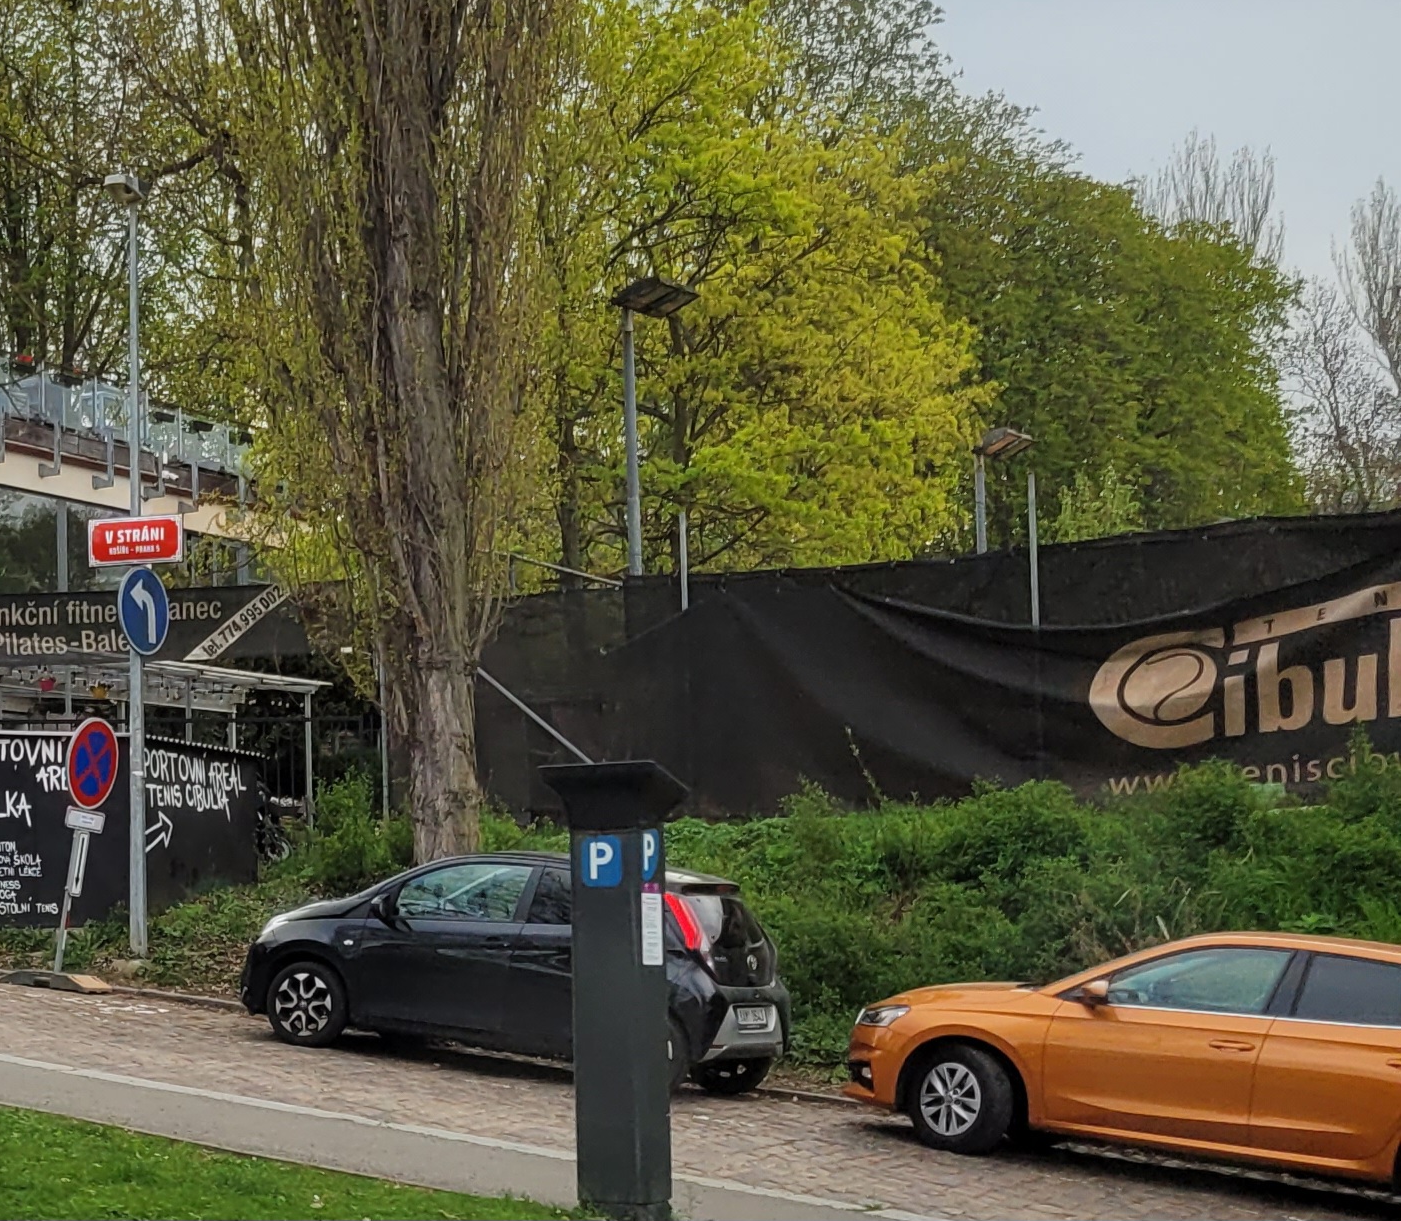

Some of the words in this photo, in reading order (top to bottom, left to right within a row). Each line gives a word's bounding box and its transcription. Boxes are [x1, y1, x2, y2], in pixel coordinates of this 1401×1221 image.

[105, 530, 114, 544] V
[117, 525, 165, 544] STRÁNI
[65, 601, 118, 625] fitne
[168, 600, 222, 621] anec
[202, 637, 224, 658] tel.
[218, 620, 243, 644] 774
[240, 602, 264, 628] 995
[259, 585, 285, 611] 002
[1263, 589, 1388, 634] TEN
[1089, 616, 1401, 749] Cibul
[35, 765, 68, 792] ARE
[144, 748, 207, 787] PORTOVNÍ
[145, 783, 183, 808] TENIS
[185, 783, 230, 822] CIBULKA
[13, 851, 42, 868] ŠKOLA
[590, 841, 614, 880] P
[643, 833, 655, 871] P
[35, 903, 59, 915] TENIS
